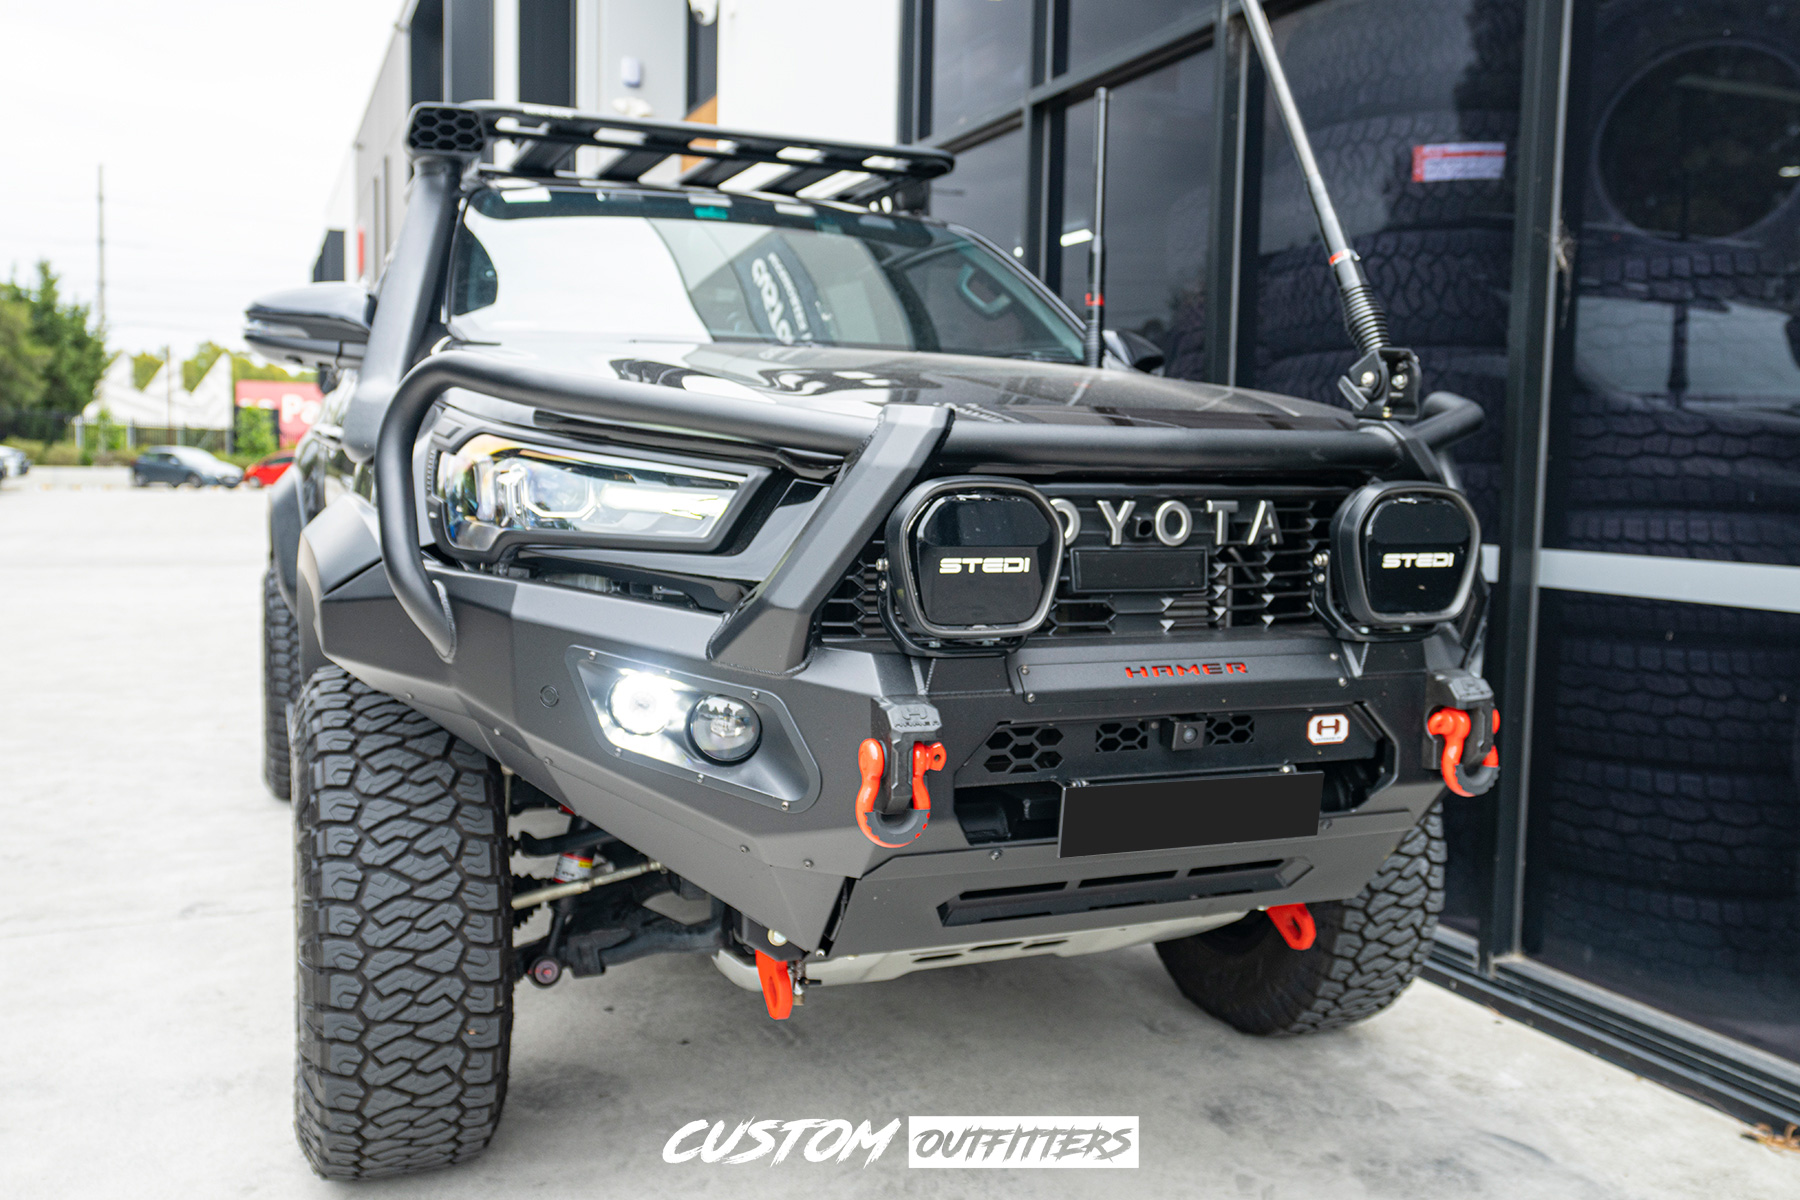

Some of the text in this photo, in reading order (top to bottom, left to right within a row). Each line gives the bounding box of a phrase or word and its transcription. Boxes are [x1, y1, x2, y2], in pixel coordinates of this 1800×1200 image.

[1050, 499, 1284, 546] OYOTA
[939, 557, 1030, 574] STEDI
[1381, 552, 1455, 569] STEDI
[1125, 662, 1248, 678] HAMER
